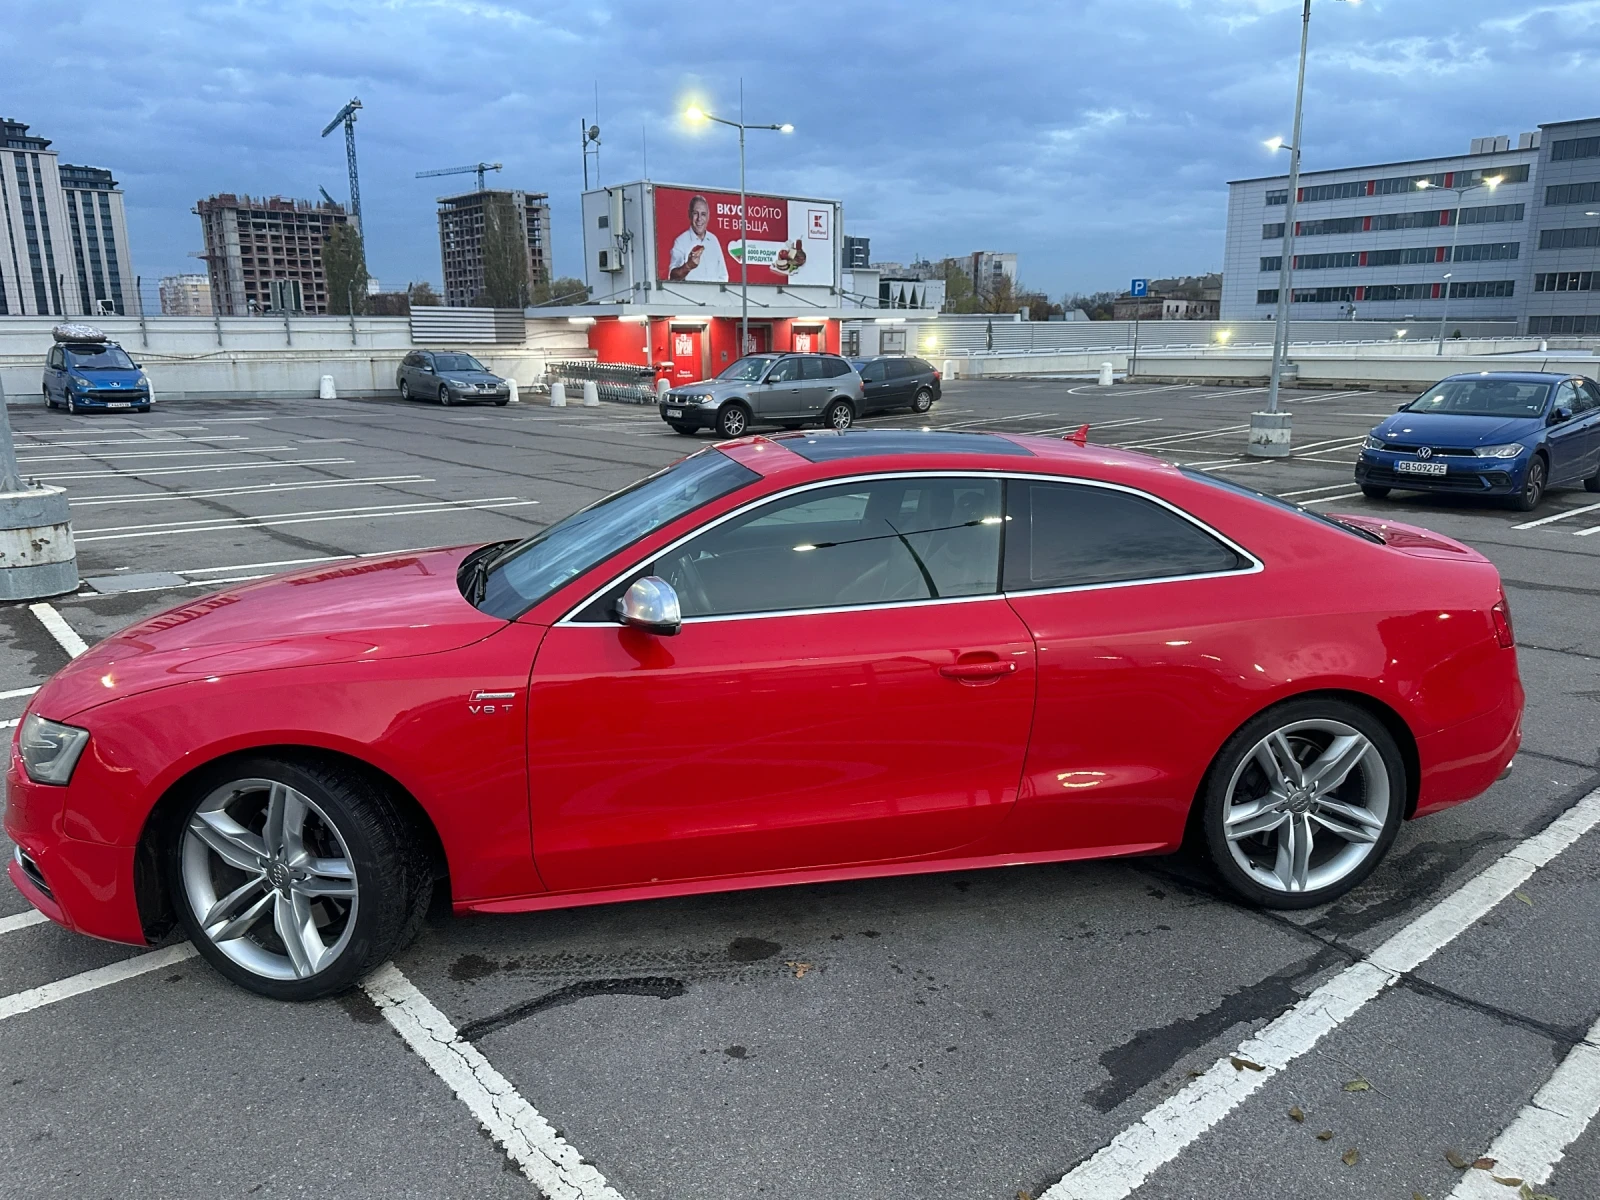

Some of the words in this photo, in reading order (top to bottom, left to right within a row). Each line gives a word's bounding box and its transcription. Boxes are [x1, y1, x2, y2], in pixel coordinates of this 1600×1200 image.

[747, 205, 782, 220] КОЙТО
[716, 217, 730, 230] ТЕ
[747, 255, 774, 263] ПРОДУКТА
[1134, 281, 1144, 295] P
